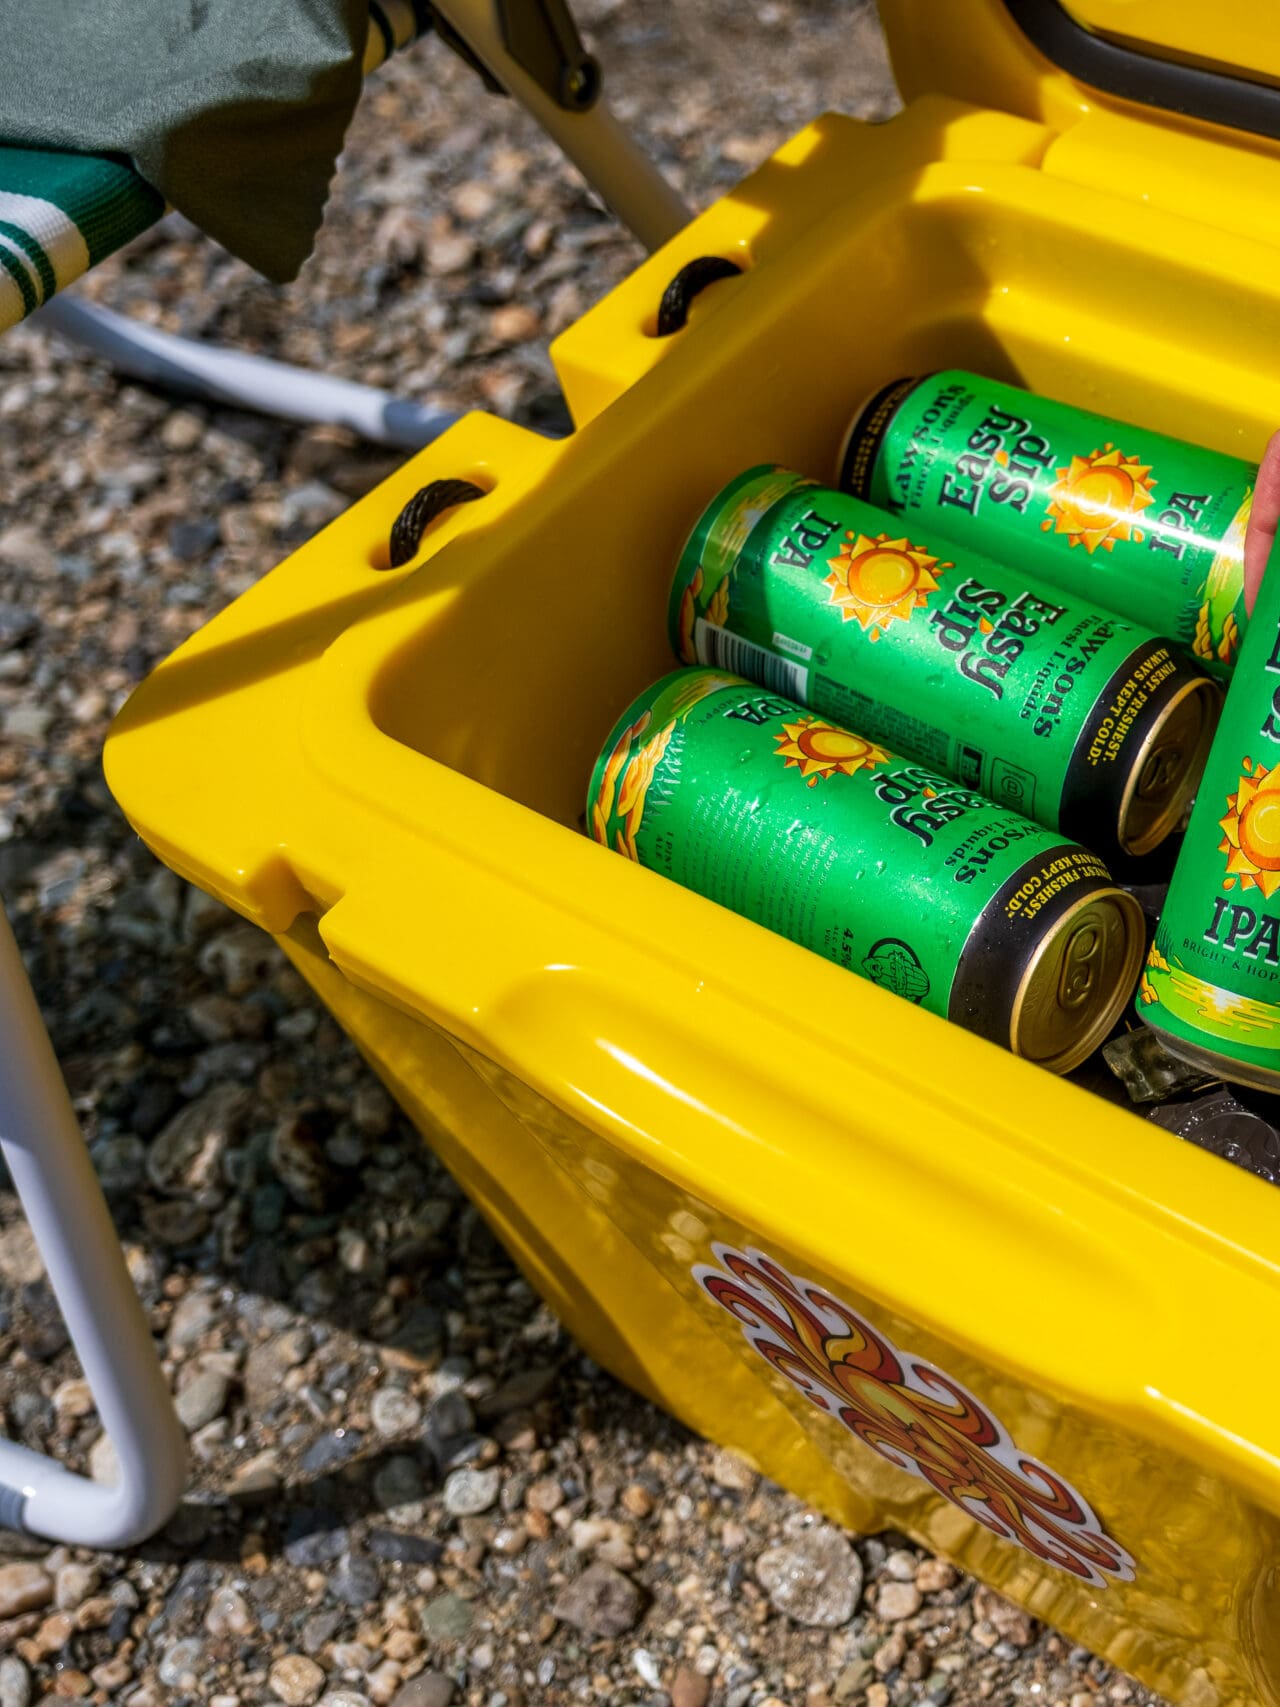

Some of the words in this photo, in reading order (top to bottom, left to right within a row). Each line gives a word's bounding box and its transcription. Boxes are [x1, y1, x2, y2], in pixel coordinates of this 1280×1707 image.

[938, 405, 1032, 517] Easy
[988, 434, 1058, 515] Sip
[769, 510, 842, 569] IPA
[1148, 491, 1213, 561] IPA
[928, 577, 1008, 652] Sip
[956, 591, 1069, 701] Easy
[1137, 648, 1171, 682] ALWAYS
[1032, 619, 1116, 739] Lawson's
[1109, 682, 1138, 718] KEPT
[1146, 661, 1177, 693] FINEST.
[1103, 691, 1148, 762] FRESHEST.
[944, 823, 1005, 867] Liquids
[1042, 855, 1073, 882] KEPT
[1020, 865, 1081, 920] FRESHEST.
[1183, 938, 1228, 964] BRIGHT
[1232, 960, 1242, 971] &
